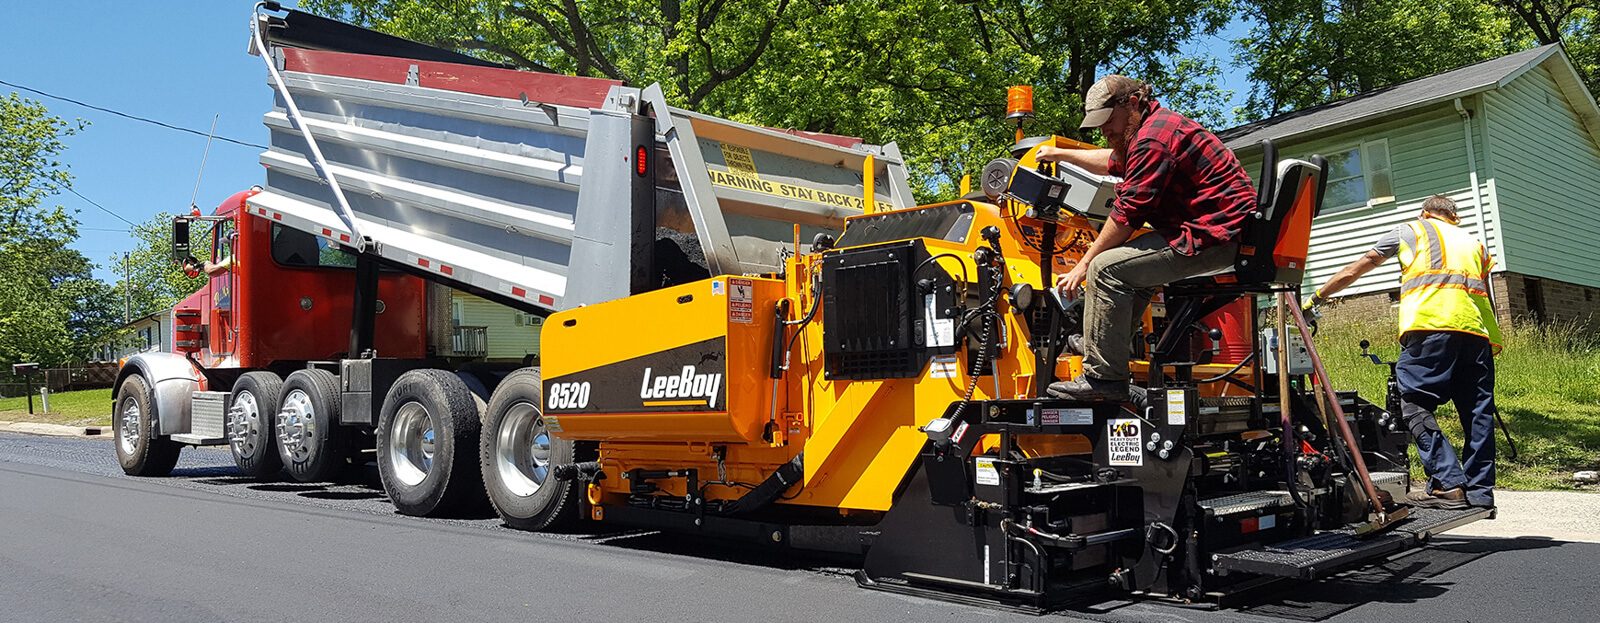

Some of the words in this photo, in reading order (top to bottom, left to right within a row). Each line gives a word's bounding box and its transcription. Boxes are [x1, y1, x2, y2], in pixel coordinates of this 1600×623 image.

[780, 184, 812, 200] STAY
[817, 191, 853, 208] BACK
[548, 381, 591, 410] 8520
[640, 365, 722, 409] LeeBoy
[1111, 453, 1140, 464] LeeBoy
